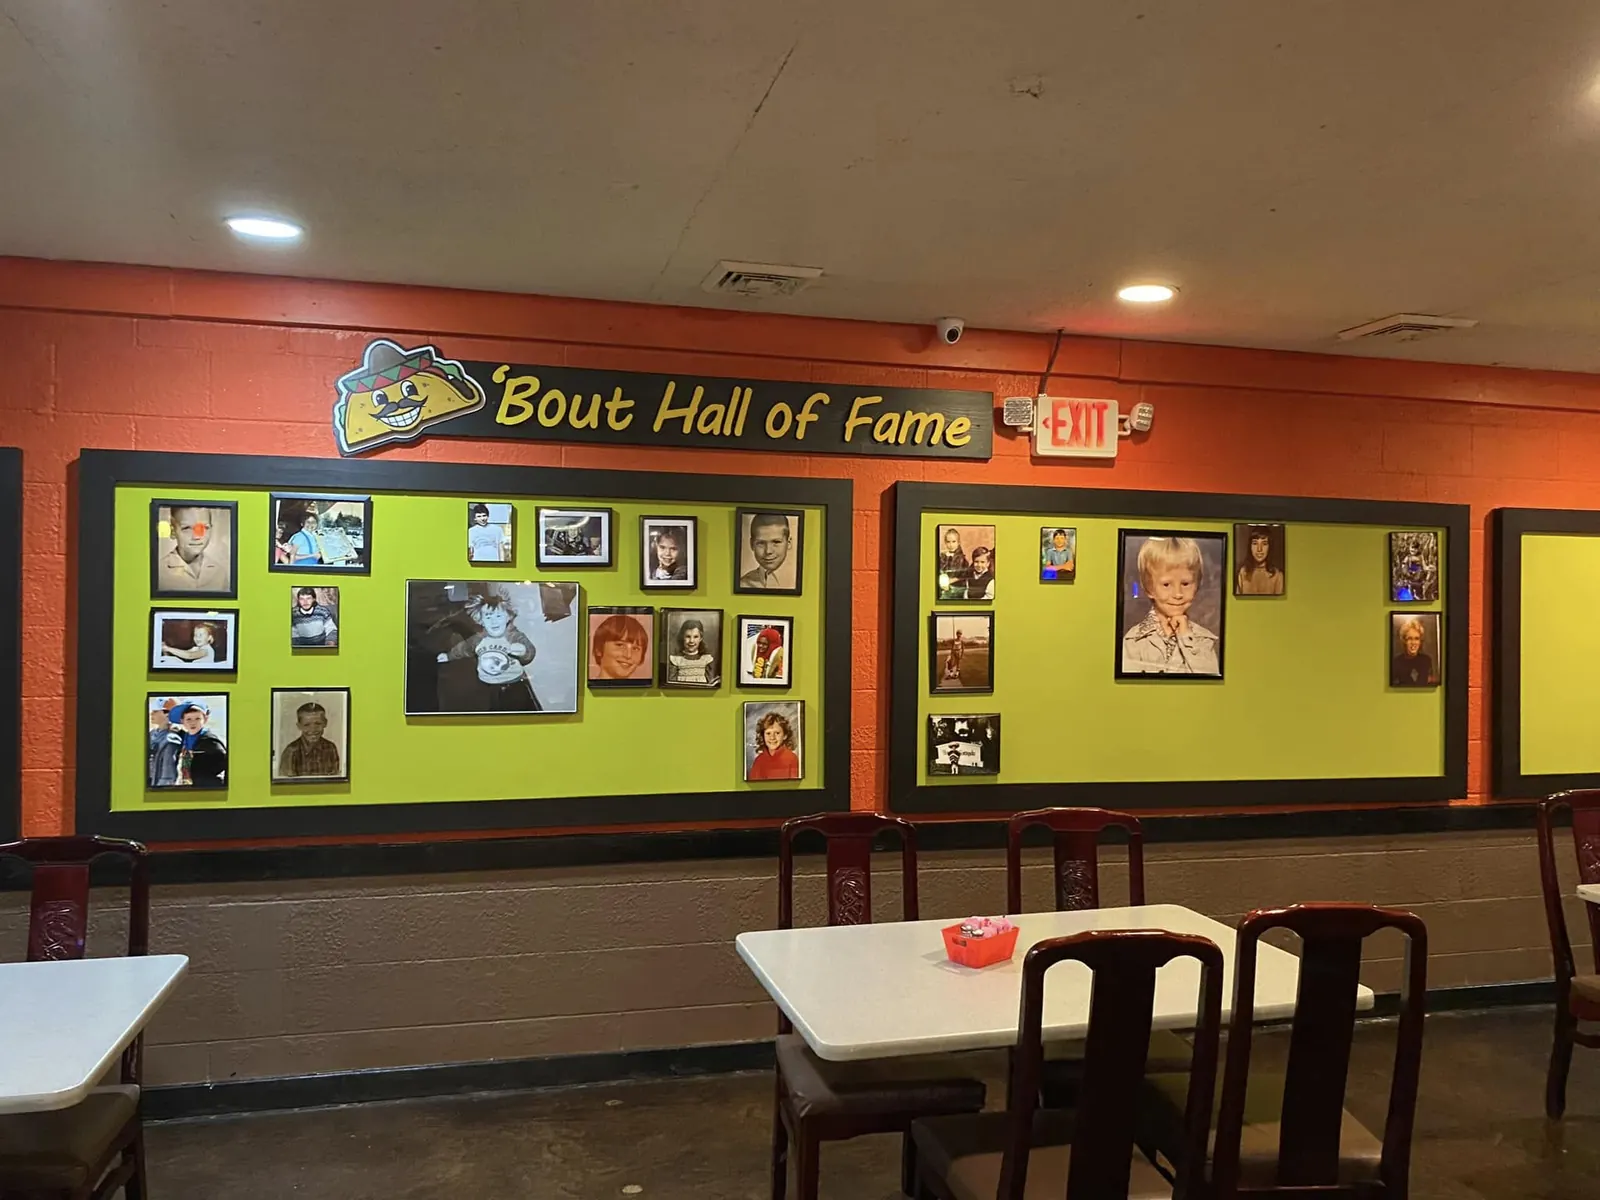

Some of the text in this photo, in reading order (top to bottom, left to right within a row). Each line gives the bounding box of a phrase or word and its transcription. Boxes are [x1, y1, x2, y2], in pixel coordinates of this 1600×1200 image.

[654, 381, 753, 437] Hall
[766, 393, 831, 440] of
[844, 396, 973, 447] Fame
[1051, 401, 1108, 448] EXIT
